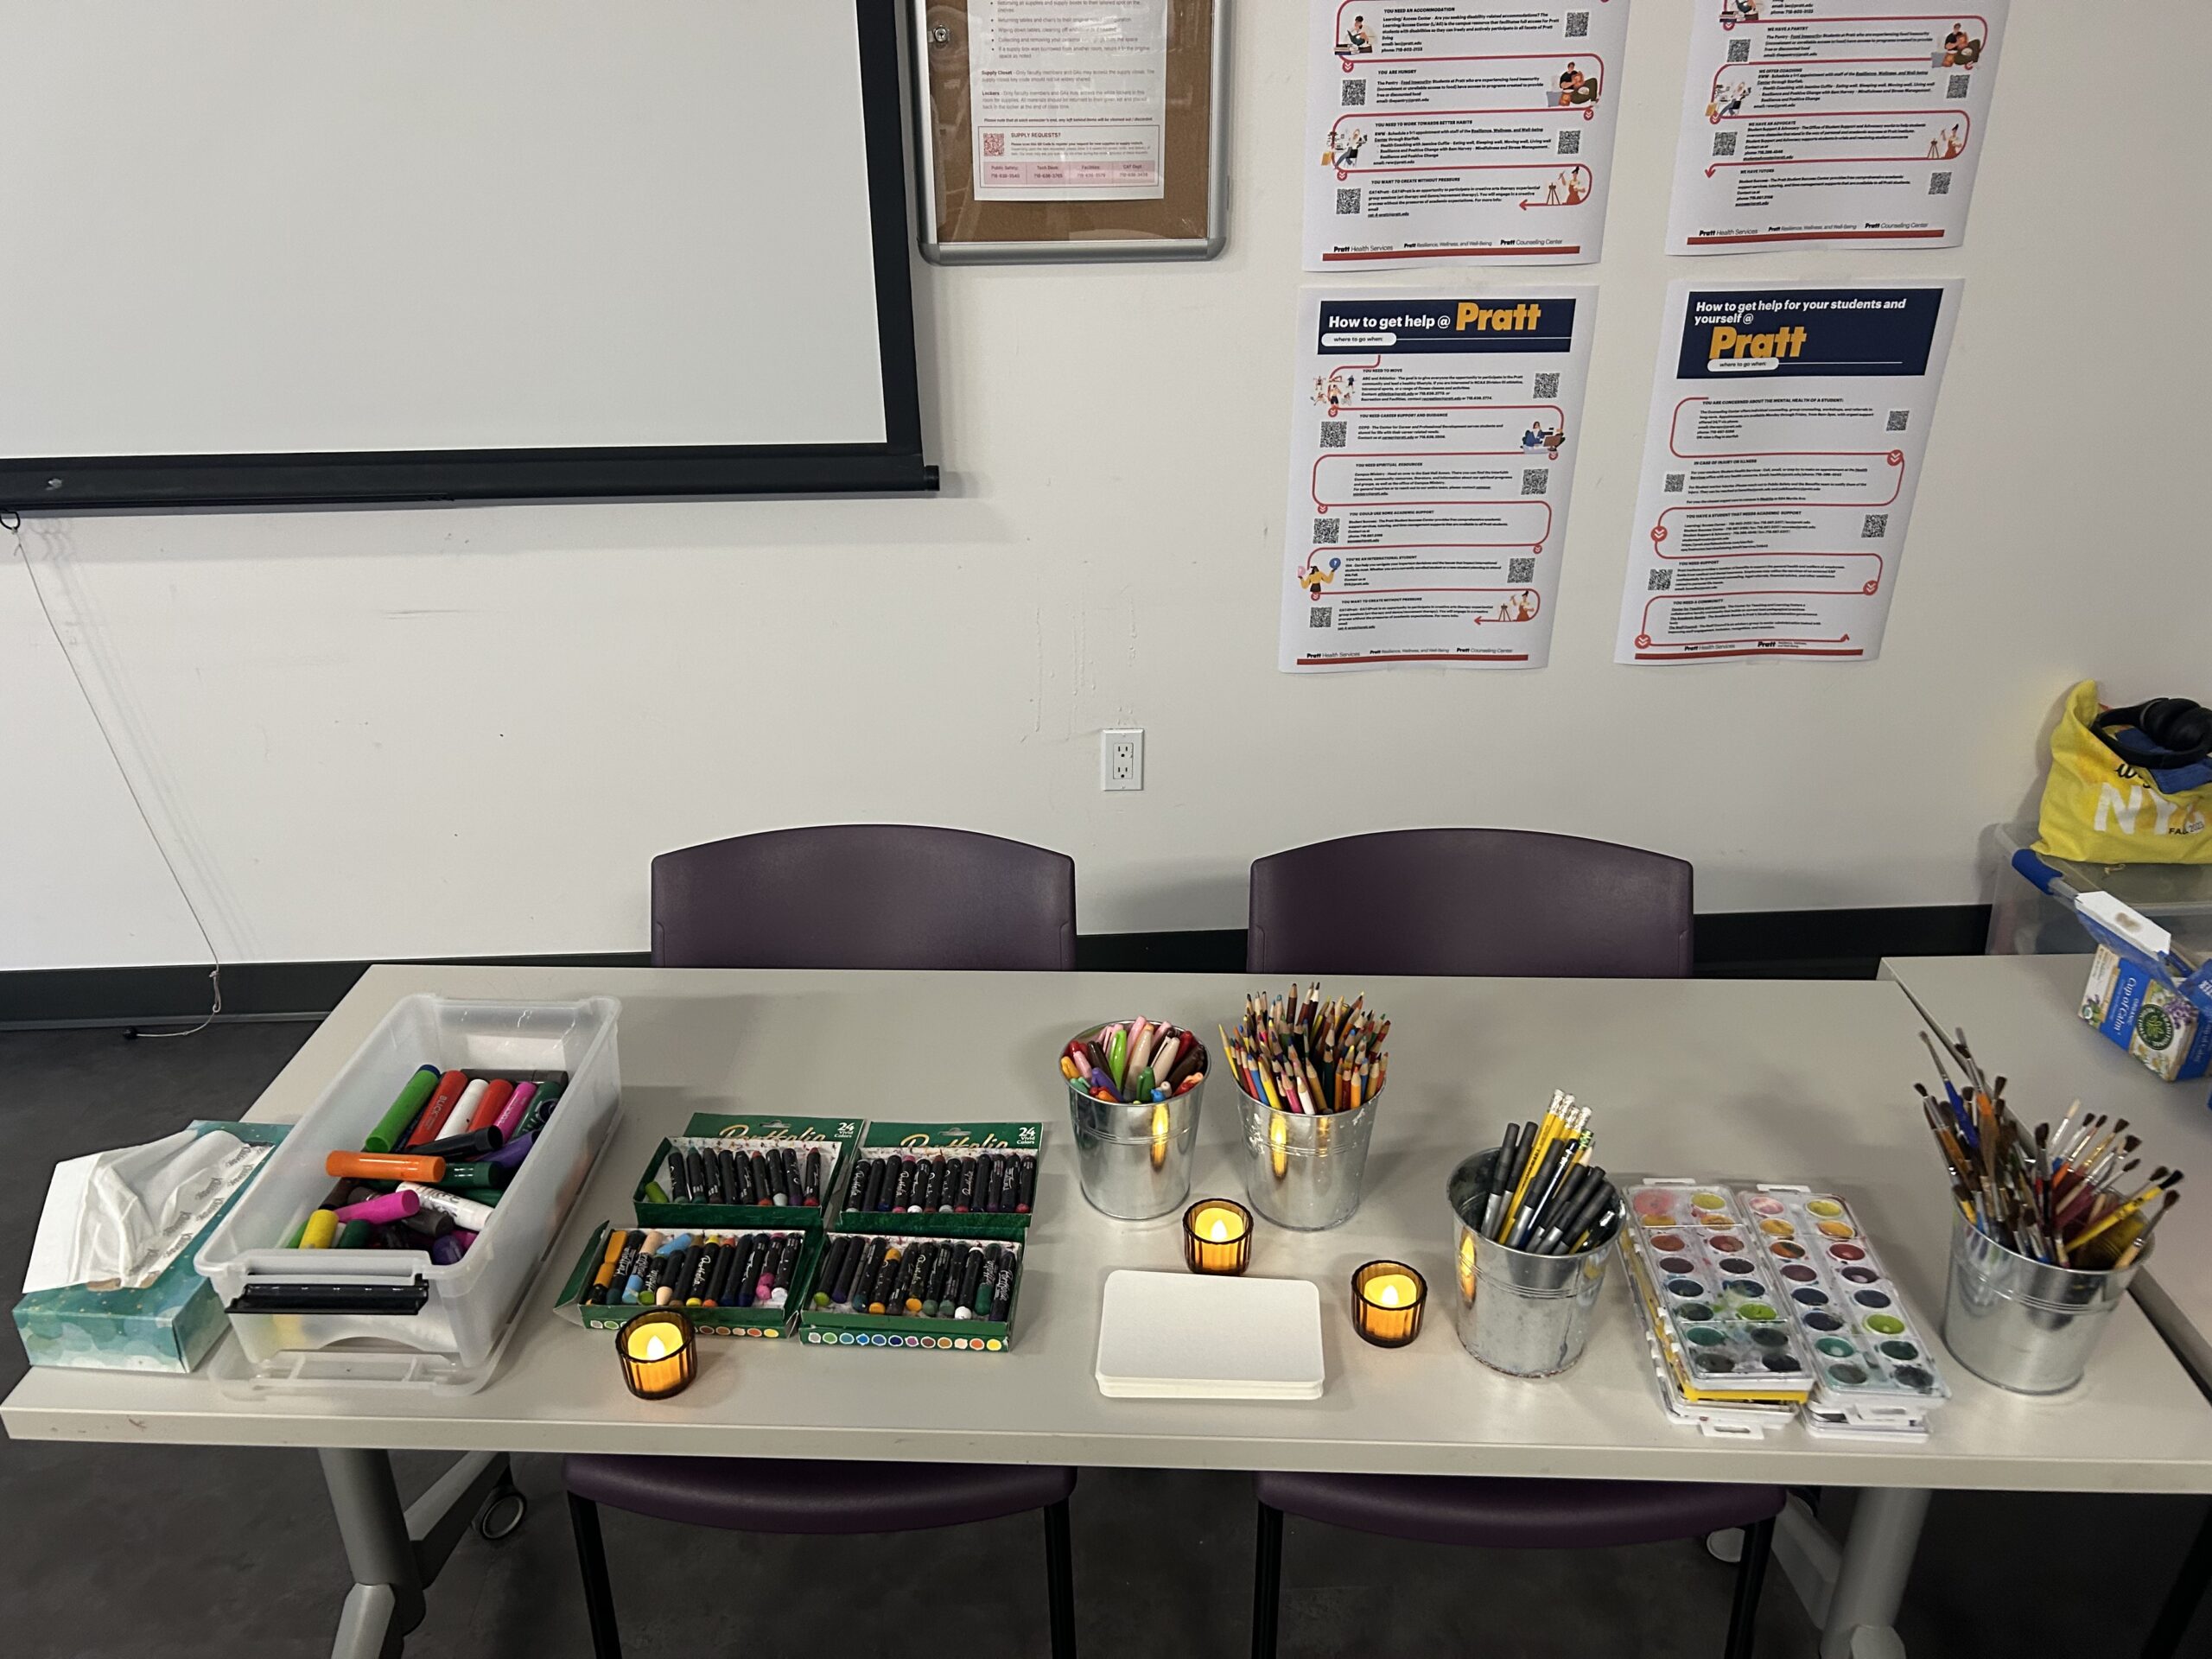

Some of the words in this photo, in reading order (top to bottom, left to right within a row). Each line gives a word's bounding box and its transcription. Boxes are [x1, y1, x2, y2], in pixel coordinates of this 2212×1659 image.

[1696, 301, 1722, 312] How
[1725, 301, 1736, 312] to
[1738, 301, 1756, 314] get
[1758, 301, 1782, 314] help
[1783, 300, 1800, 311] for
[1802, 302, 1828, 313] your
[1830, 299, 1881, 310] students
[1883, 299, 1905, 309] and
[1328, 315, 1359, 328] How
[1363, 315, 1376, 328] to
[1379, 315, 1402, 331] get
[1404, 315, 1434, 331] help
[1437, 315, 1450, 327] @
[1456, 302, 1541, 331] Pratt
[1694, 314, 1741, 327] yourself
[1743, 313, 1753, 323] @
[1710, 326, 1808, 359] Pratt
[2124, 977, 2137, 993] Cup
[2121, 995, 2130, 1007] of
[2113, 1007, 2128, 1032] Calm
[431, 1095, 447, 1116] BLICK
[837, 1122, 855, 1131] 24
[1019, 1128, 1035, 1136] 24
[692, 1255, 710, 1286] Portfolio
